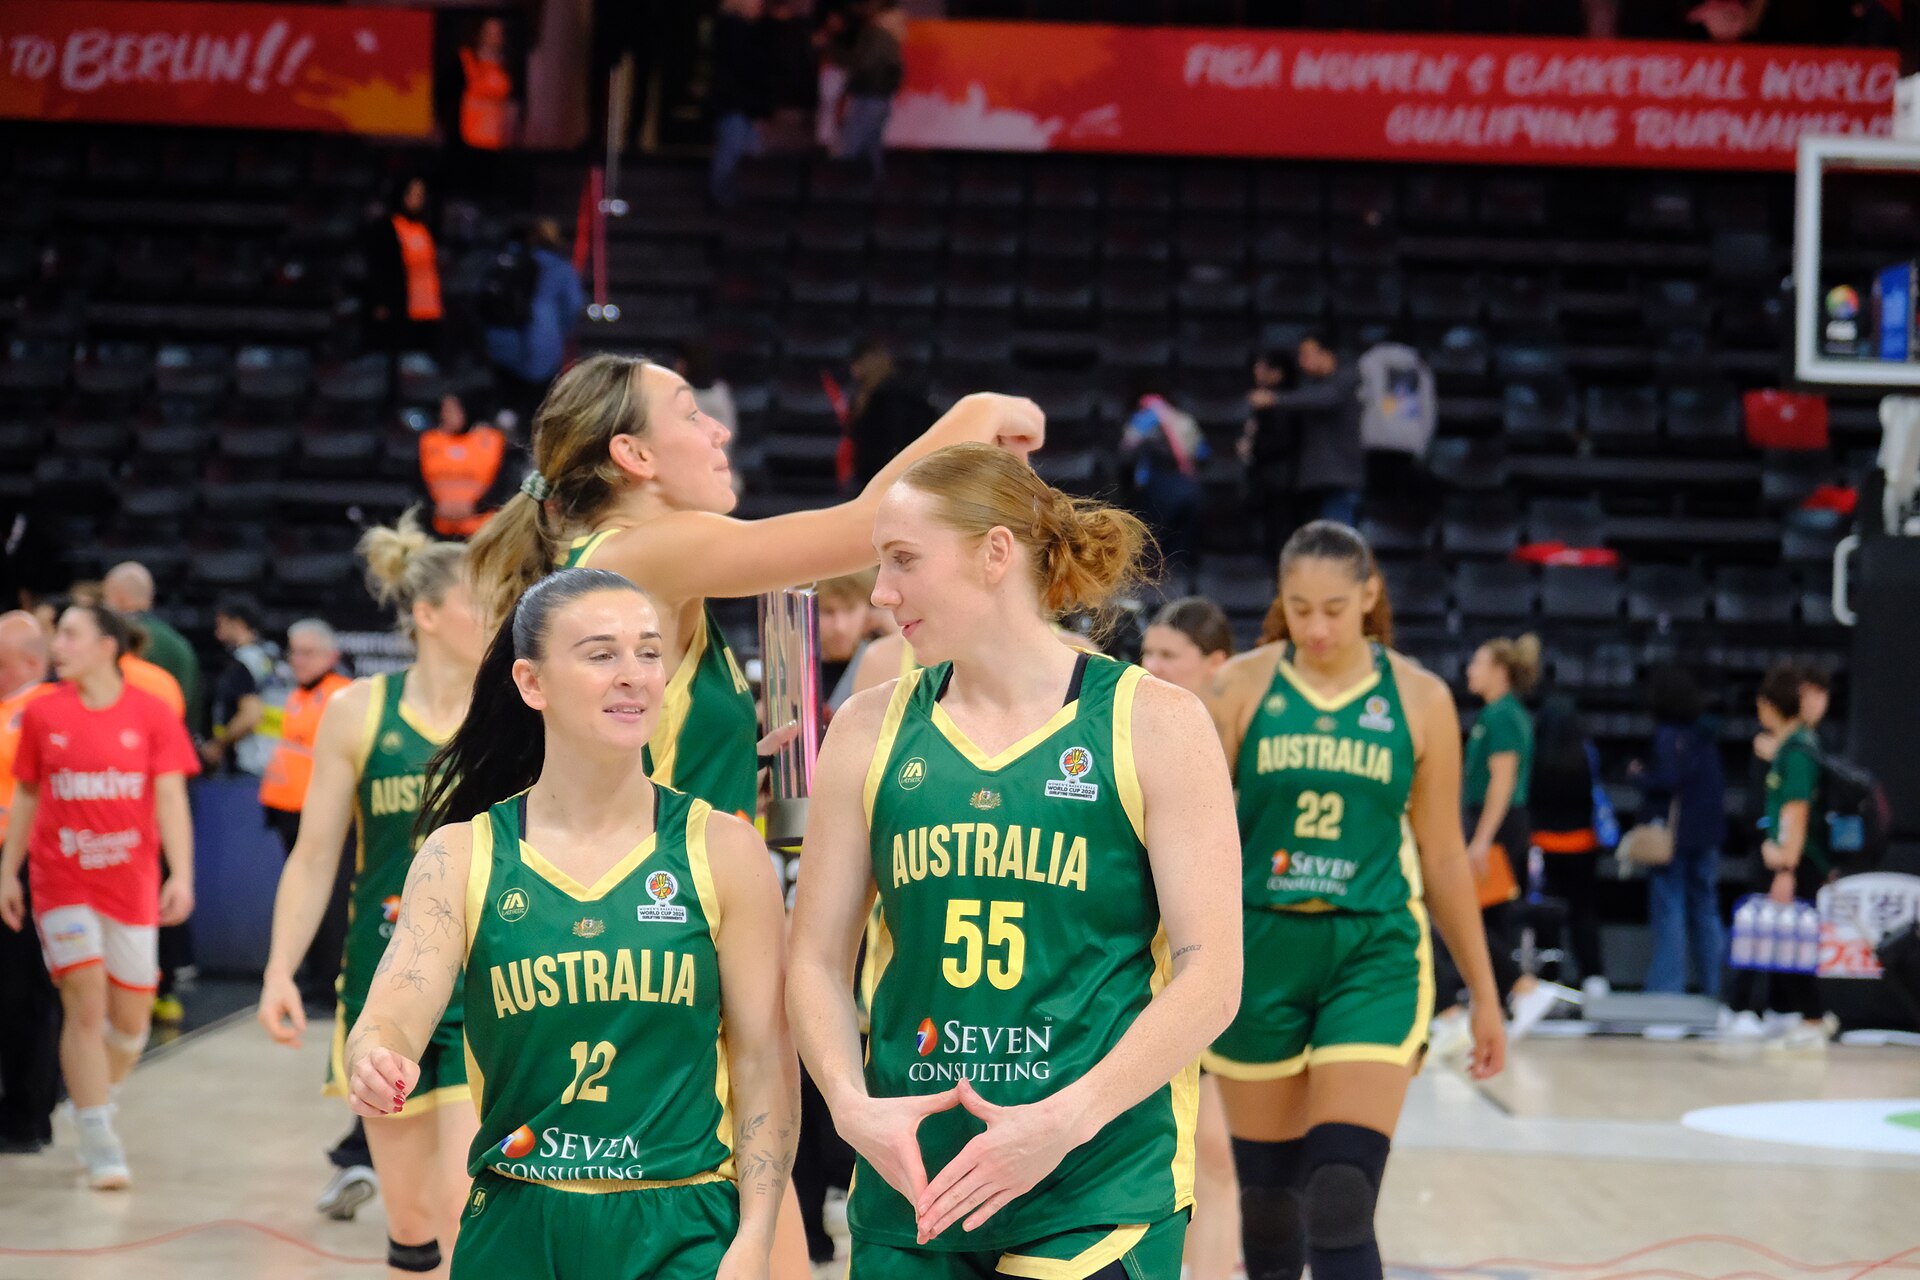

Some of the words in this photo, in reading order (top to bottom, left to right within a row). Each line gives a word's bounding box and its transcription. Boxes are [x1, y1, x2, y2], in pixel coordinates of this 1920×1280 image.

[9, 34, 56, 80] TO
[1503, 54, 1747, 99] BASKETBALL
[1760, 60, 1898, 102] WORLD
[1257, 734, 1393, 785] AUSTRALIA
[1294, 790, 1345, 841] 22
[892, 822, 1088, 892] AUSTRALIA
[1289, 850, 1358, 880] SEVEN
[942, 899, 1025, 990] 55
[490, 948, 695, 1019] AUSTRALIA
[943, 1019, 1052, 1055] SEVEN
[560, 1040, 617, 1105] 12
[908, 1061, 1050, 1082] CONSULTING
[539, 1127, 641, 1161] SEVEN
